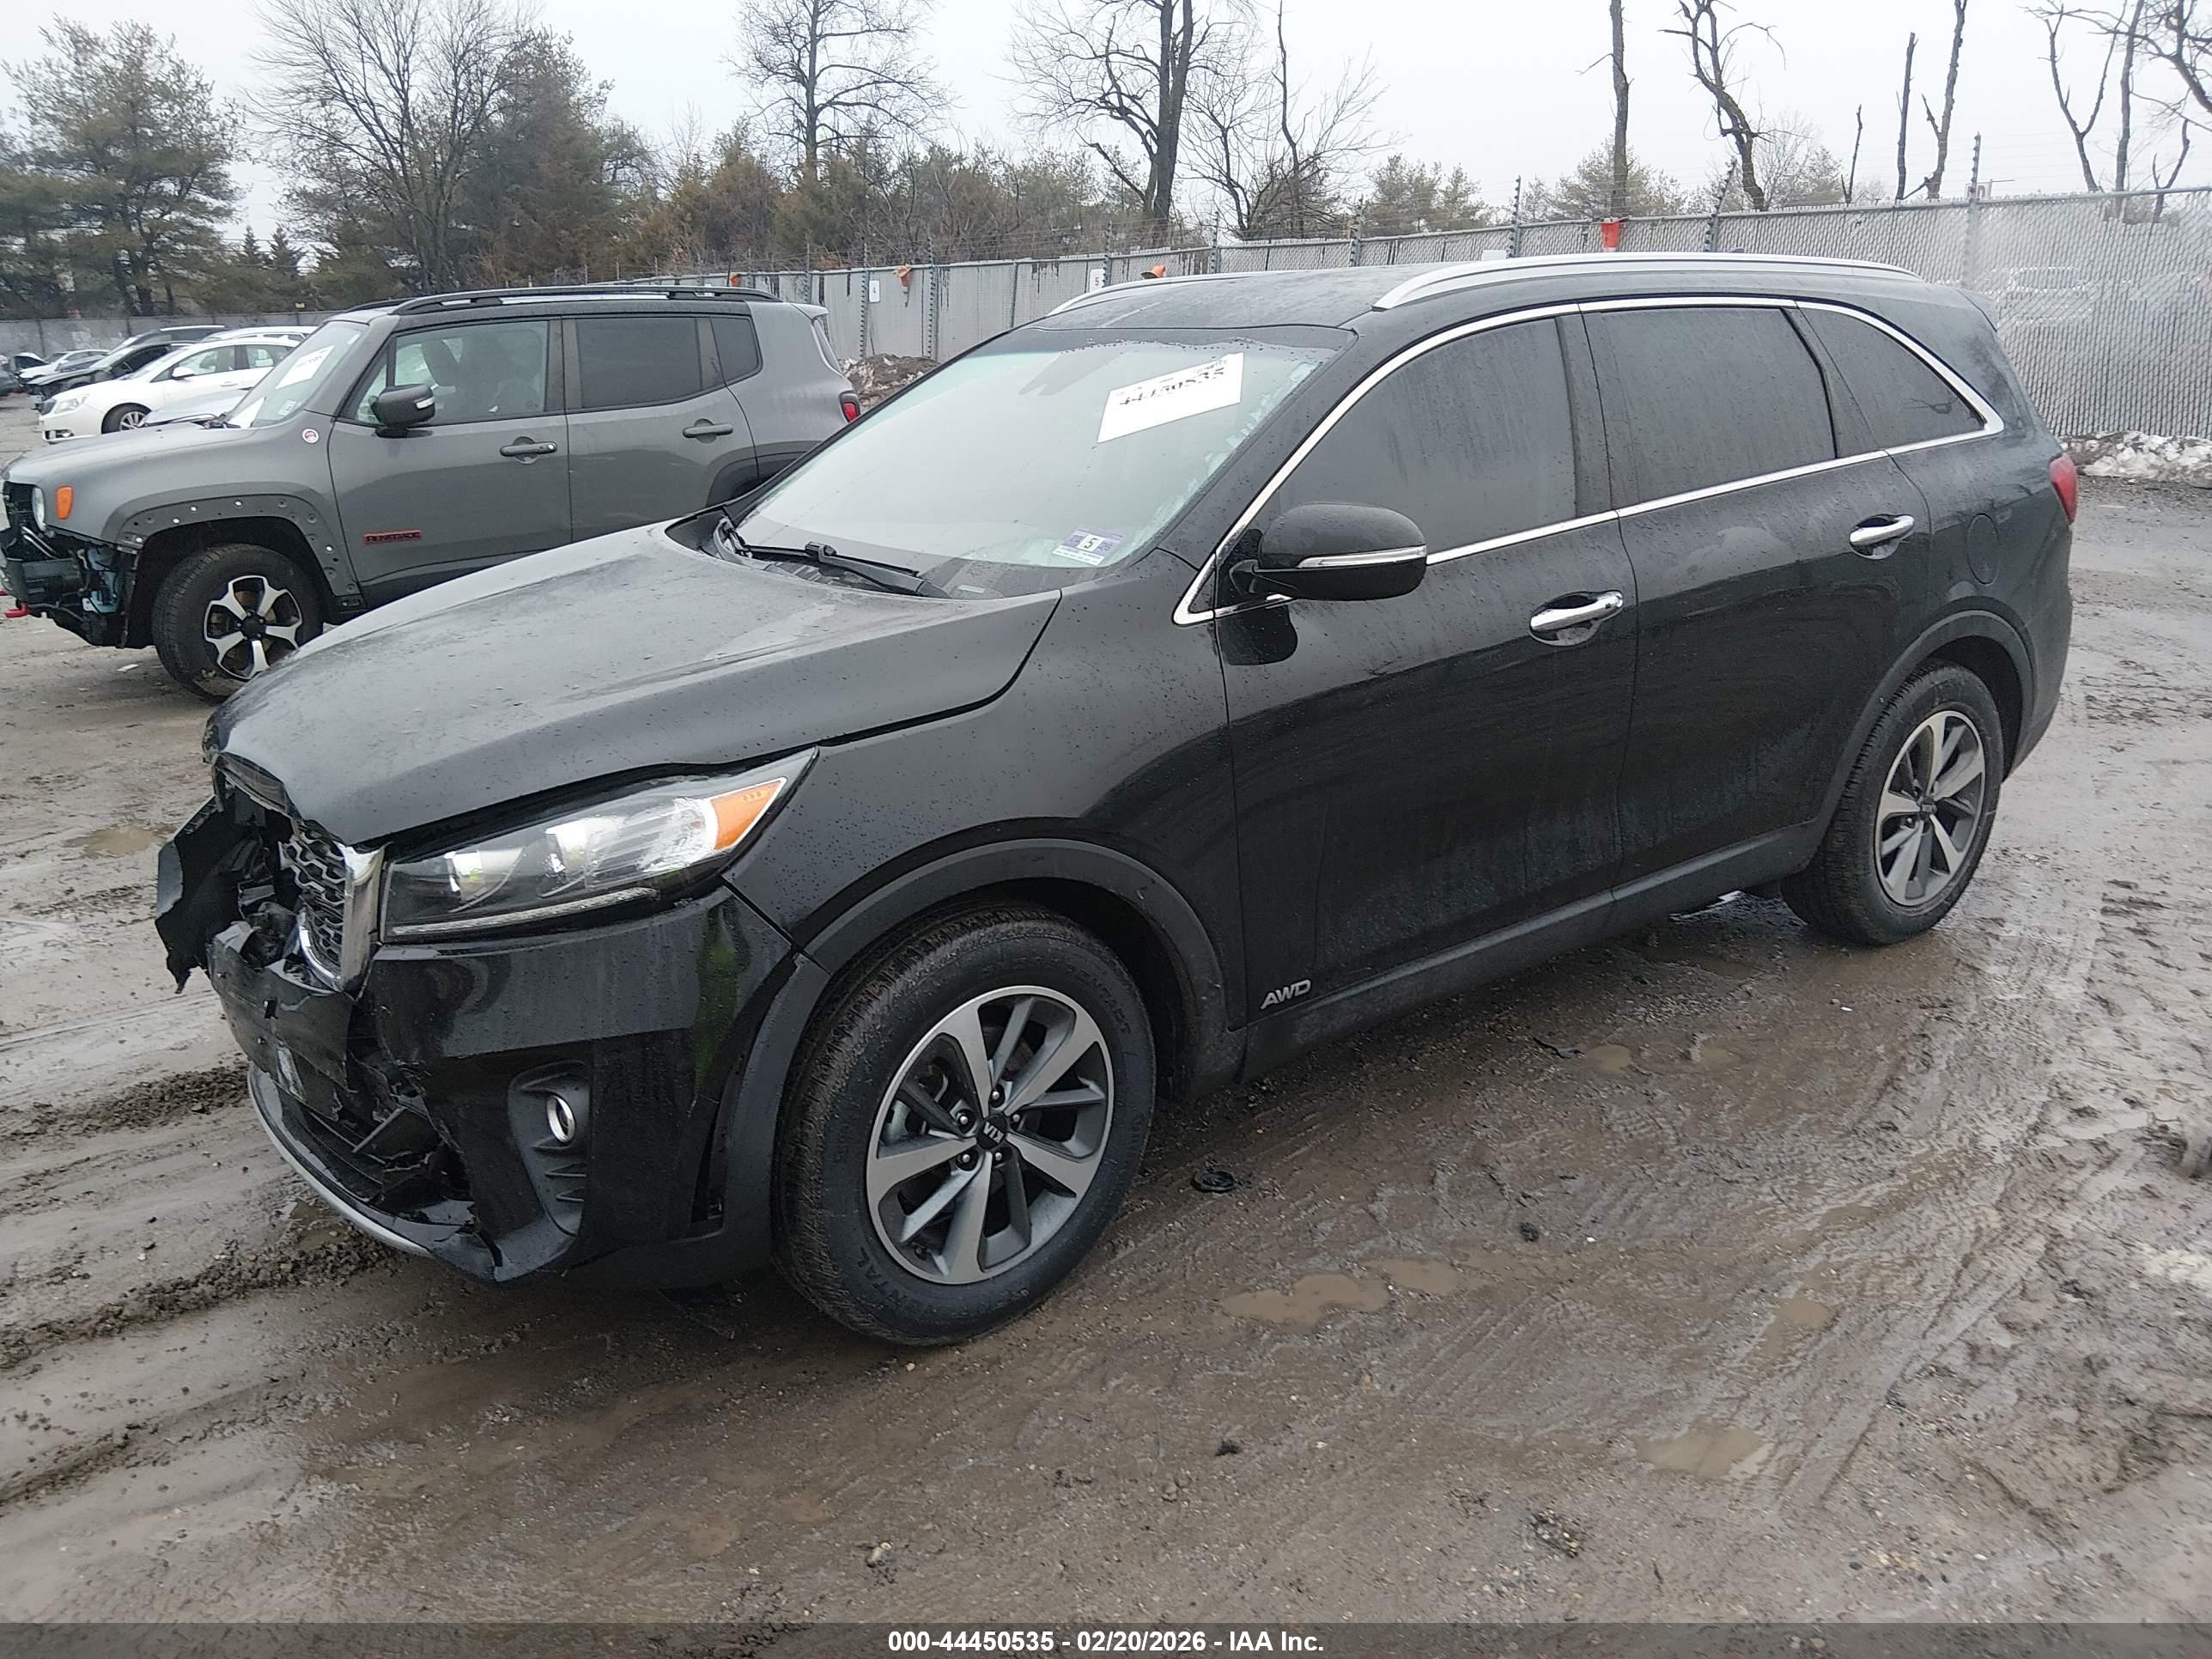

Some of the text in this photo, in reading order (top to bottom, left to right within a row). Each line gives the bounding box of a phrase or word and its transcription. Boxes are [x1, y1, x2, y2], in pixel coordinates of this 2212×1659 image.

[1094, 276, 1100, 287] 5
[1084, 537, 1098, 550] 5
[1260, 979, 1311, 1010] AWD
[983, 1121, 1005, 1144] KIA
